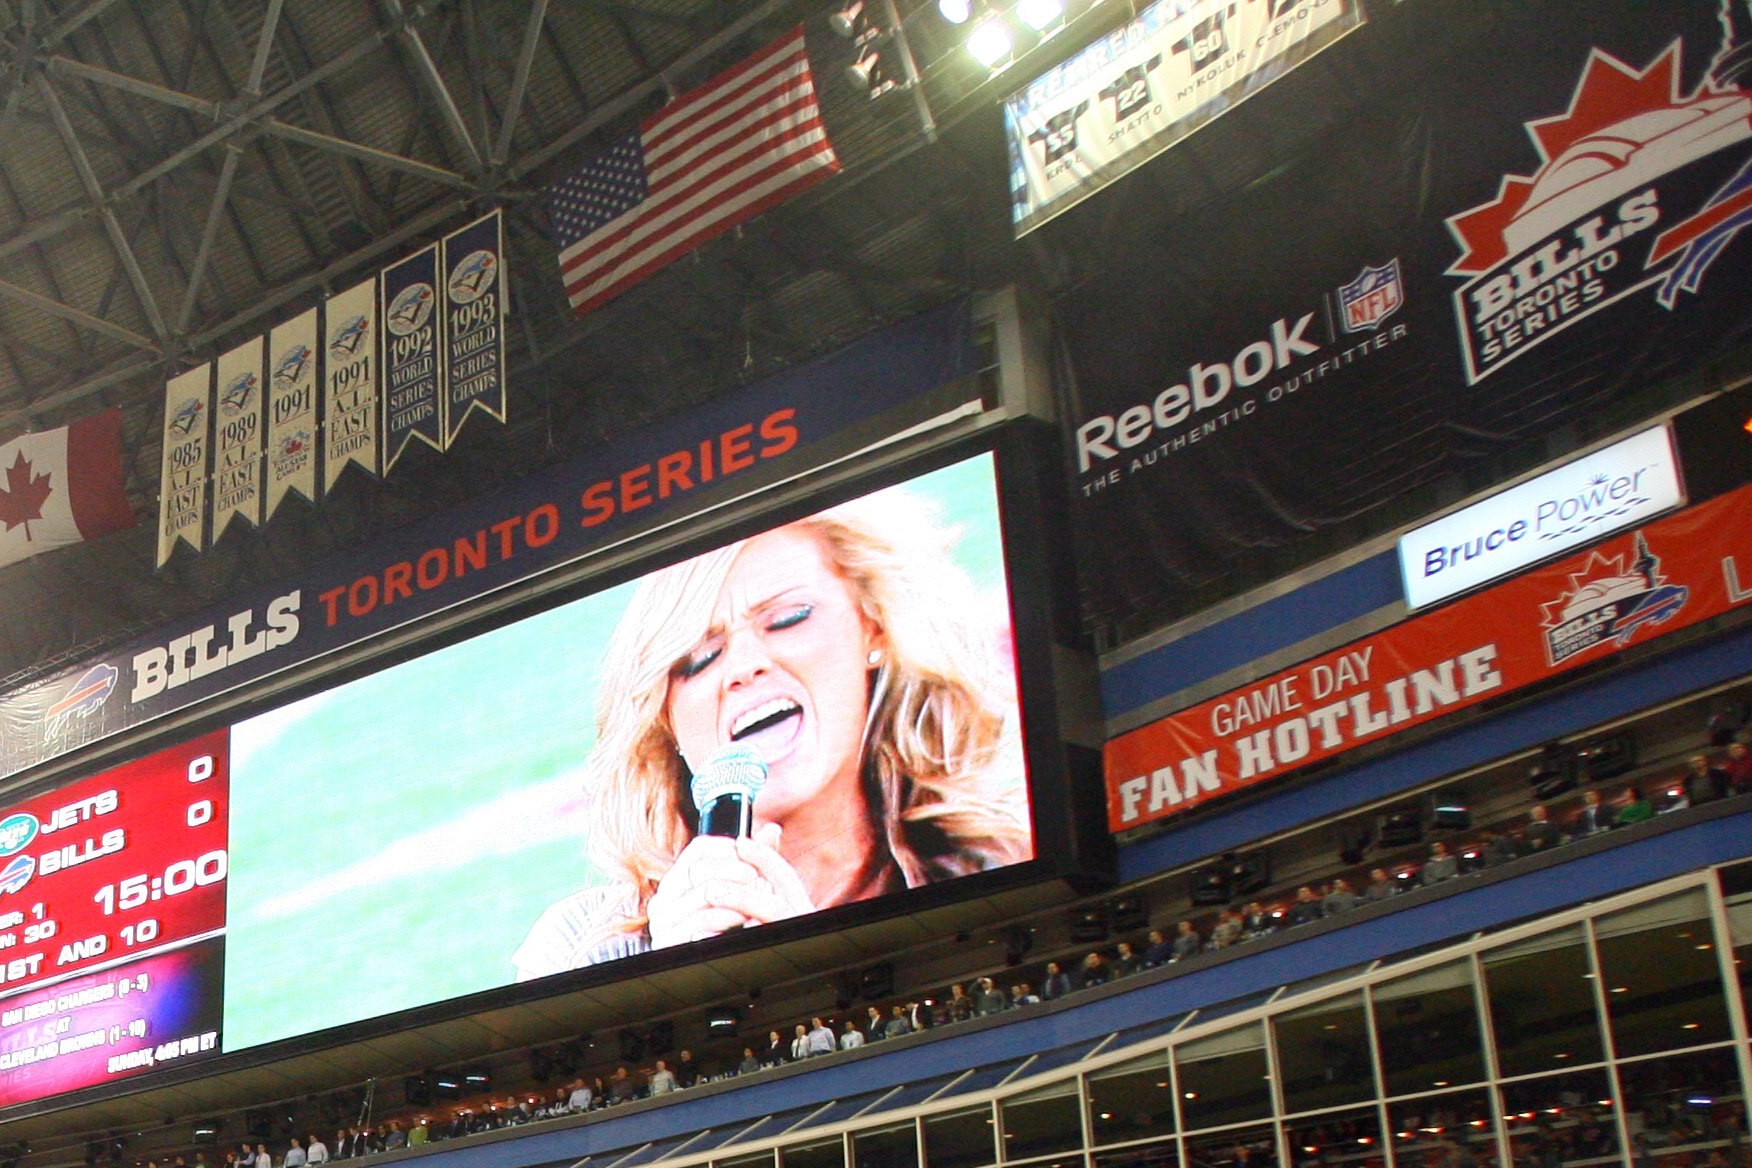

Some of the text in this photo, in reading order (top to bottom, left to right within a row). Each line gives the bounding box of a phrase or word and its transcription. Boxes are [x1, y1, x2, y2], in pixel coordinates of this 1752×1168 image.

[1176, 49, 1246, 102] NYKOLUK
[1118, 80, 1147, 110] 22
[1471, 188, 1661, 325] BILLS
[450, 292, 496, 338] 1993
[1349, 286, 1398, 325] NFL
[1478, 250, 1619, 342] TORONTO
[1481, 279, 1603, 363] SERIES
[391, 325, 433, 369] 1992
[452, 326, 496, 358] WORLD
[329, 355, 370, 397] 1991
[391, 356, 433, 388] WORLD
[452, 350, 496, 384] SERIES
[273, 384, 311, 424] 1991
[390, 379, 434, 412] SERIES
[452, 374, 496, 404] CHAMPS
[1076, 311, 1321, 474] Reebok
[330, 405, 370, 443] EAST
[391, 403, 434, 432] CHAMPS
[1082, 323, 1409, 498] THE AUTHENTIC OUTFITTER
[221, 412, 257, 451] 1989
[330, 433, 371, 460] CHAMPS
[168, 438, 202, 474] 1985
[219, 462, 255, 495] EAST
[217, 487, 256, 512] CHAMPS
[1423, 467, 1647, 579] Bruce Power
[131, 409, 798, 703] BILLS TORONTO SERIES
[1210, 645, 1374, 739] GAME DAY
[1119, 643, 1503, 824] FAN HOTLINE
[188, 755, 214, 783] 0
[40, 789, 119, 834] JETS
[186, 799, 213, 827] 0
[38, 828, 126, 876] BILLS
[94, 850, 229, 916] 15:00
[31, 903, 46, 920] 1
[23, 920, 56, 944] 30
[56, 934, 108, 967] AND
[120, 919, 159, 947] 10
[1, 1006, 23, 1027] SAN
[24, 1000, 55, 1022] DIEGO
[56, 1016, 72, 1034] AT
[0, 1042, 59, 1070] CLEVELAND
[180, 1036, 199, 1056] PM
[200, 1031, 217, 1052] ET
